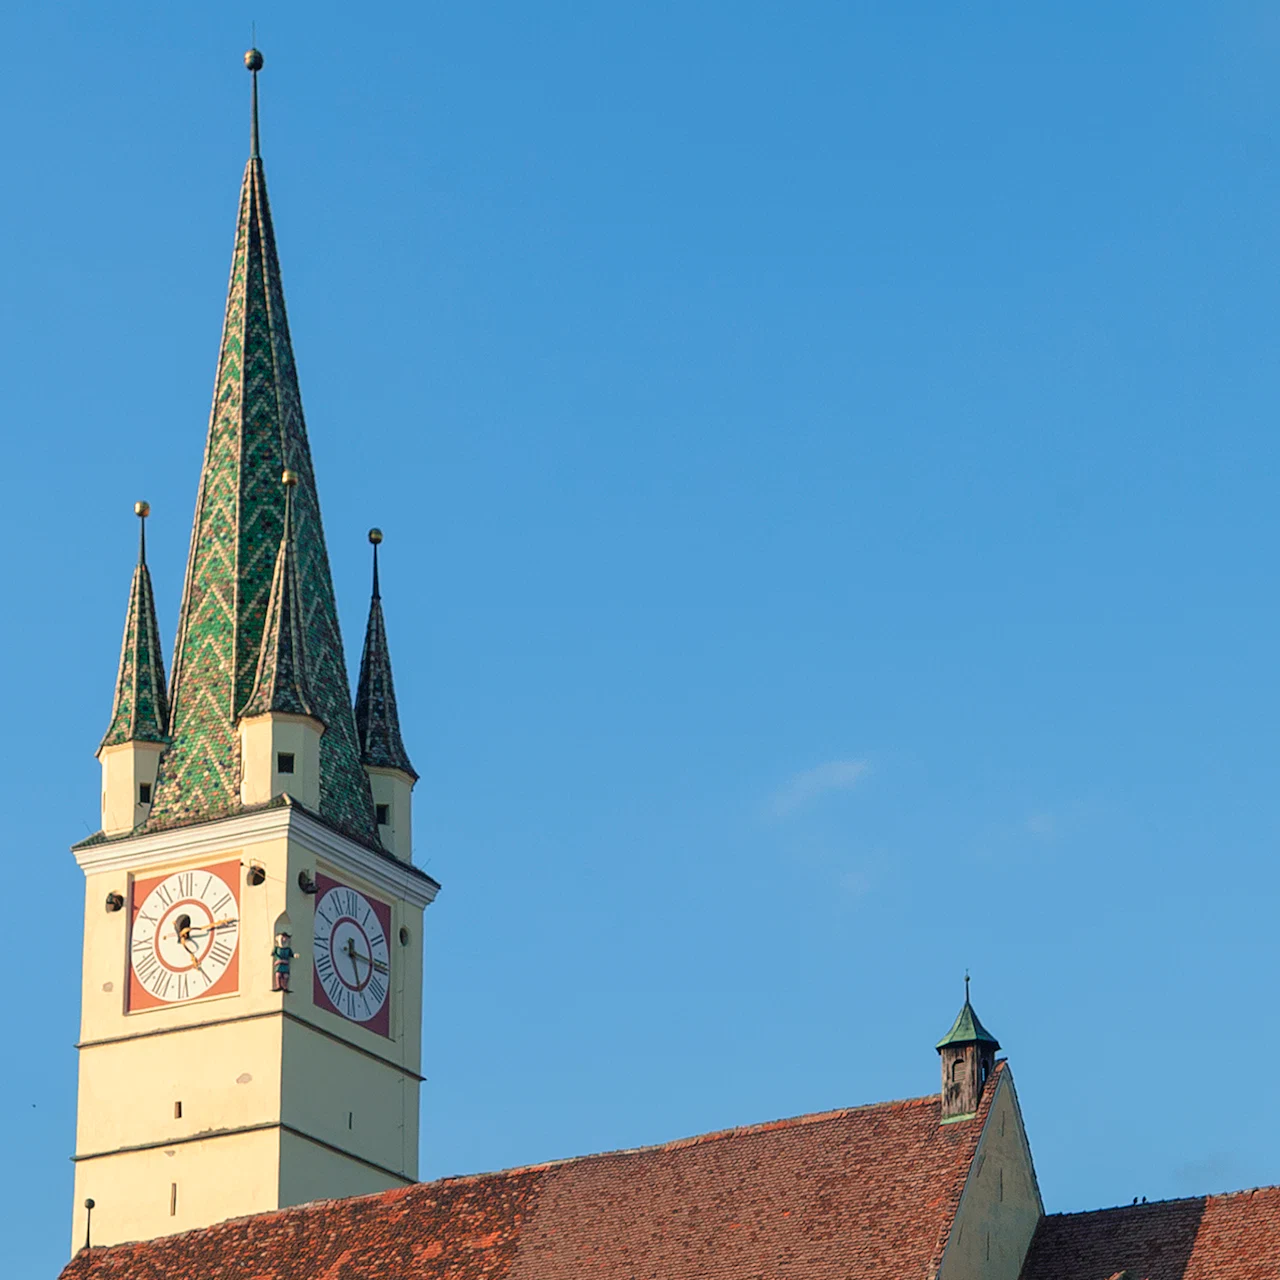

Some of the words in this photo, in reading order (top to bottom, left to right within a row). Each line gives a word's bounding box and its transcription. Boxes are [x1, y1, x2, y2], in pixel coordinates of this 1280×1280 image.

[156, 884, 174, 910] XI
[178, 872, 193, 898] XII
[211, 893, 232, 914] II
[346, 890, 358, 919] XII
